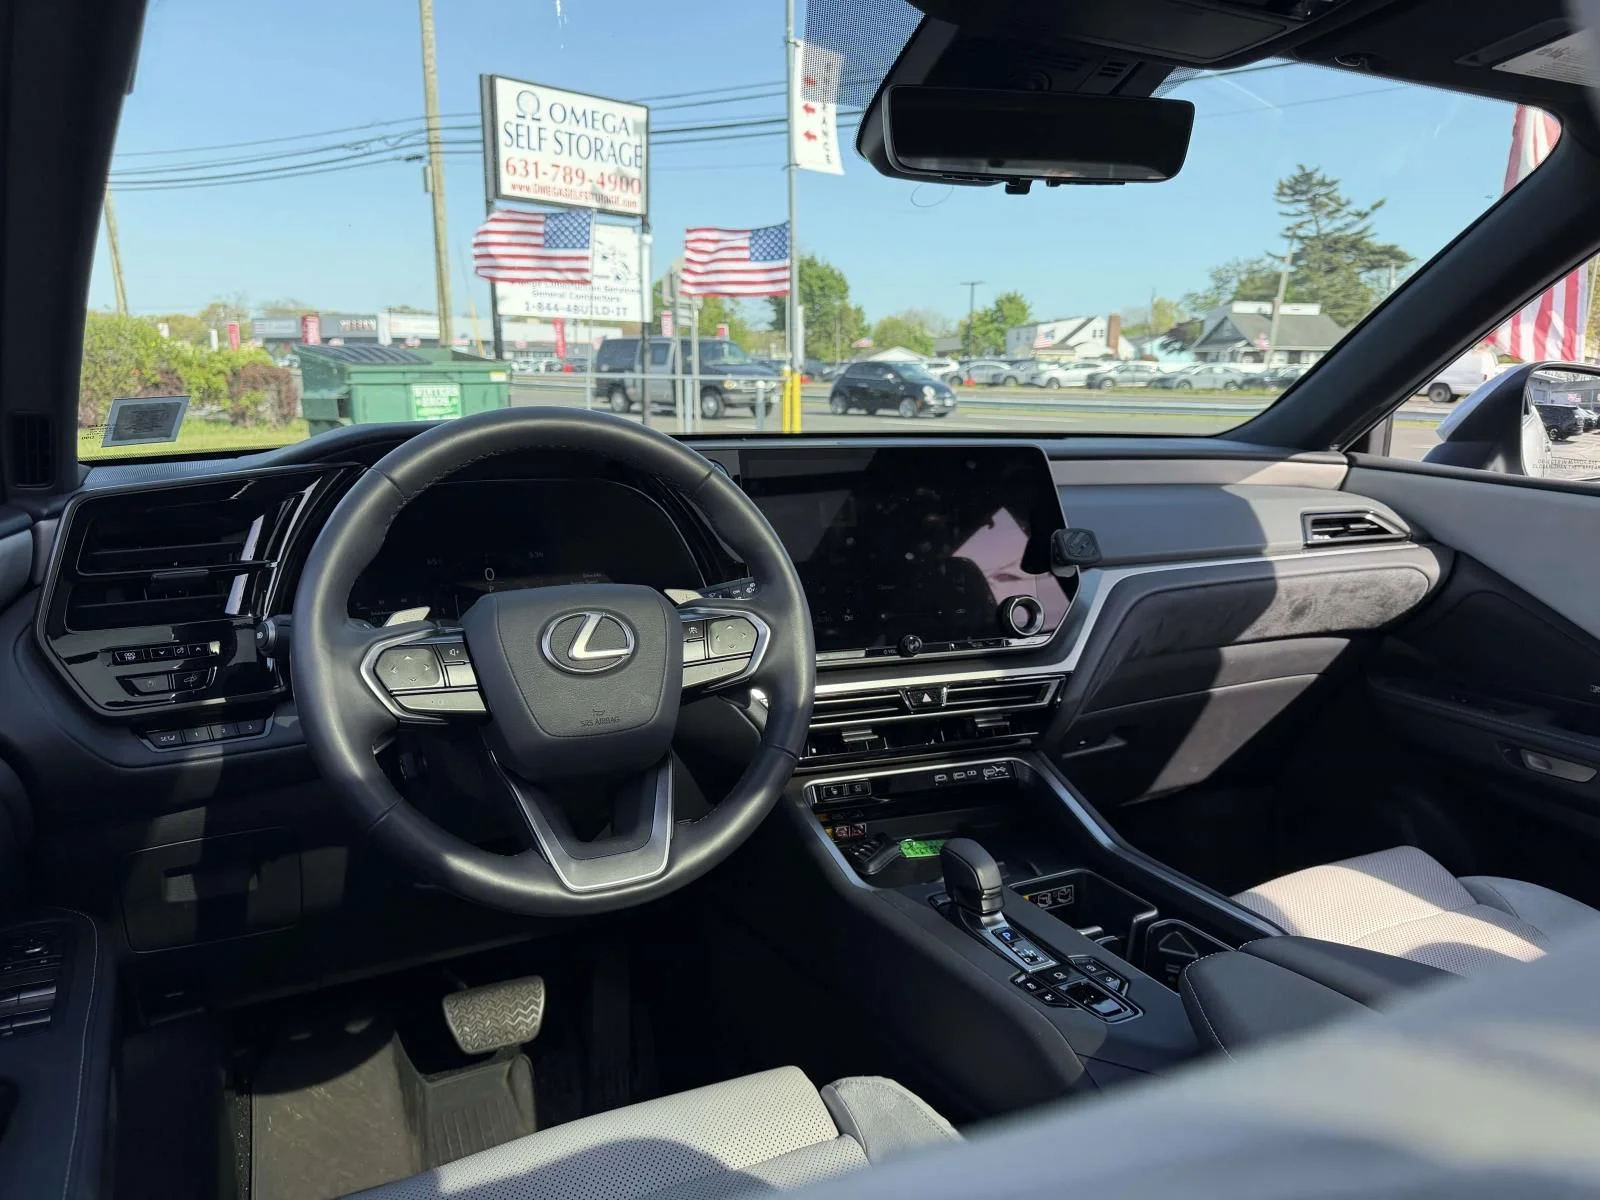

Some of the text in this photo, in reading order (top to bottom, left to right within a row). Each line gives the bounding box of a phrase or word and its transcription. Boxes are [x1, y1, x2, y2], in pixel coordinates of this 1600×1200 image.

[549, 102, 631, 137] OMEGA
[503, 121, 643, 169] SELF STORAGE
[505, 156, 642, 196] 631-789-4900
[484, 567, 496, 581] 0
